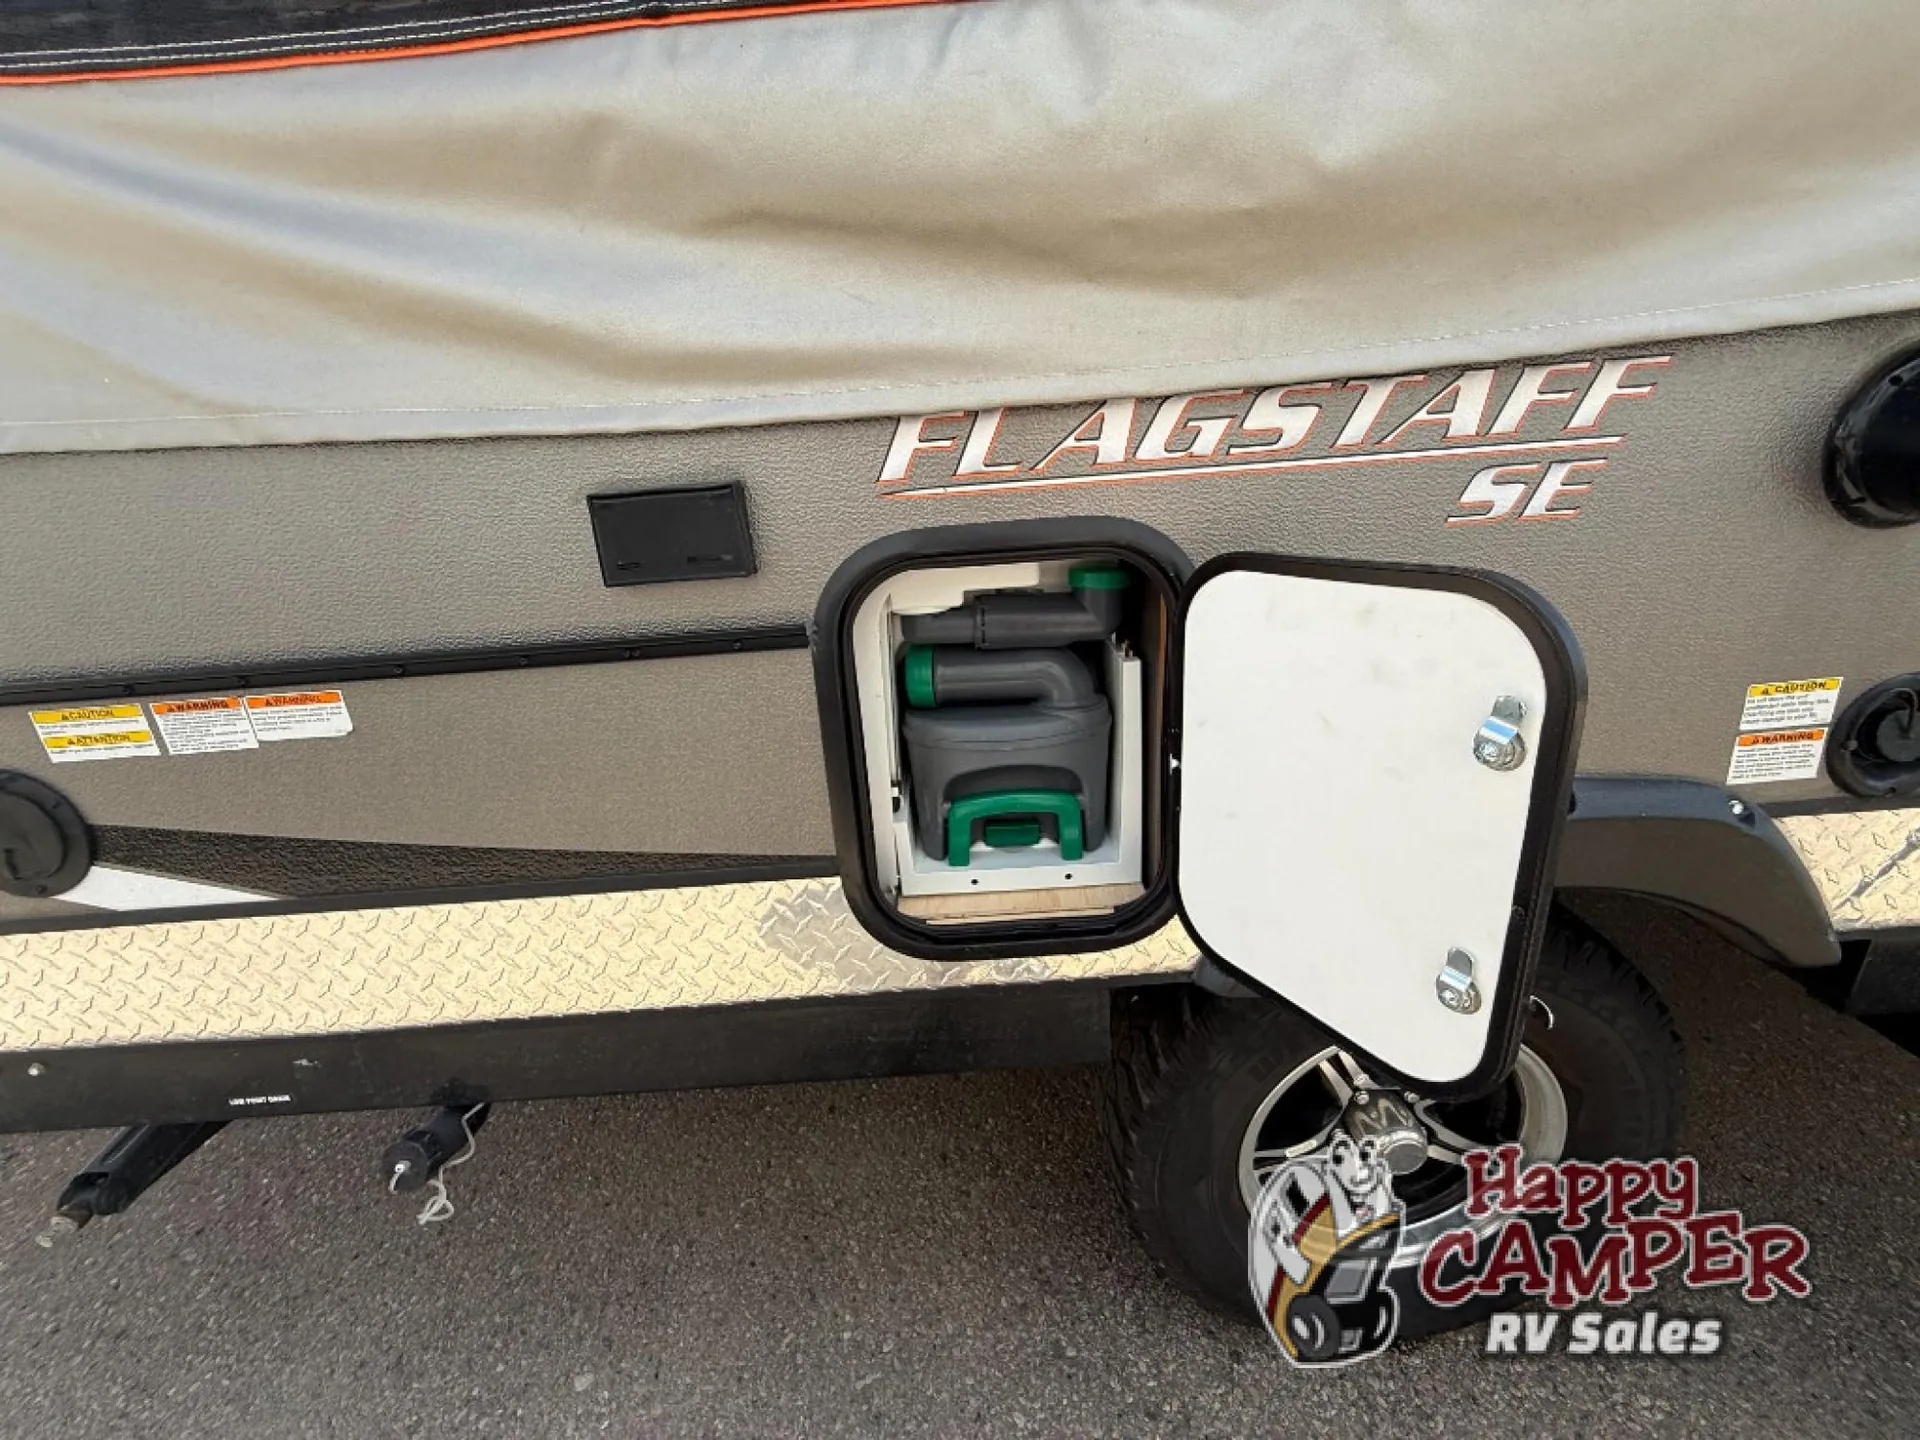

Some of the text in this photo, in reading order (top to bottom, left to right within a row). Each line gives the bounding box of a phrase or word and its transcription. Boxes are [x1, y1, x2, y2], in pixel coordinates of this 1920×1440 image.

[875, 356, 1672, 483] FLAGSTAFF
[1447, 458, 1608, 524] SE
[1774, 681, 1828, 694] CAUTION
[174, 700, 230, 712] WARNING
[68, 709, 115, 720] CAUTION
[1762, 731, 1815, 744] WARNING
